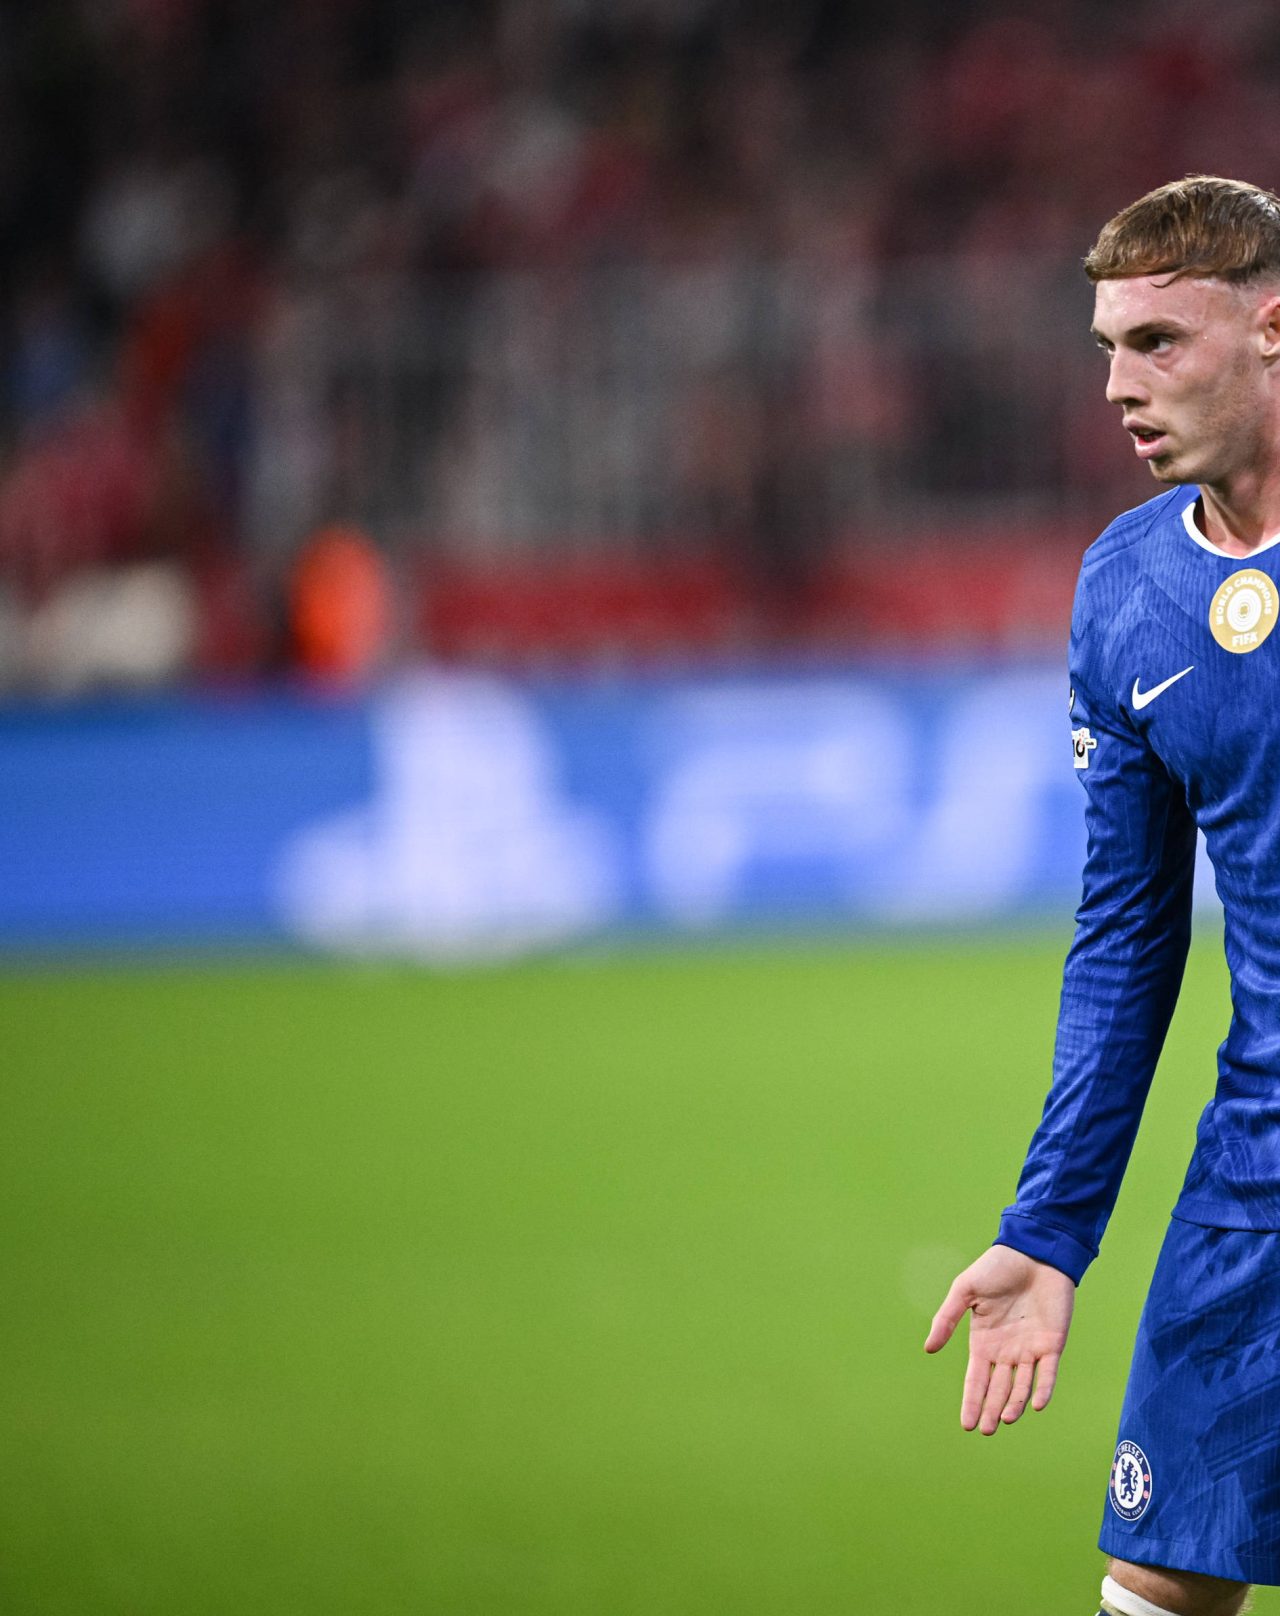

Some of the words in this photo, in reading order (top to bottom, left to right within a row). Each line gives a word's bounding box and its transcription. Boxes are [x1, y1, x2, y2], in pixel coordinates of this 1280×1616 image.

[1216, 585, 1233, 624] WORLD
[1234, 576, 1272, 615] CHAMPIONS
[1231, 632, 1258, 647] FIFA
[1117, 1443, 1144, 1465] CHELSEA
[1131, 1506, 1142, 1517] CLUB
